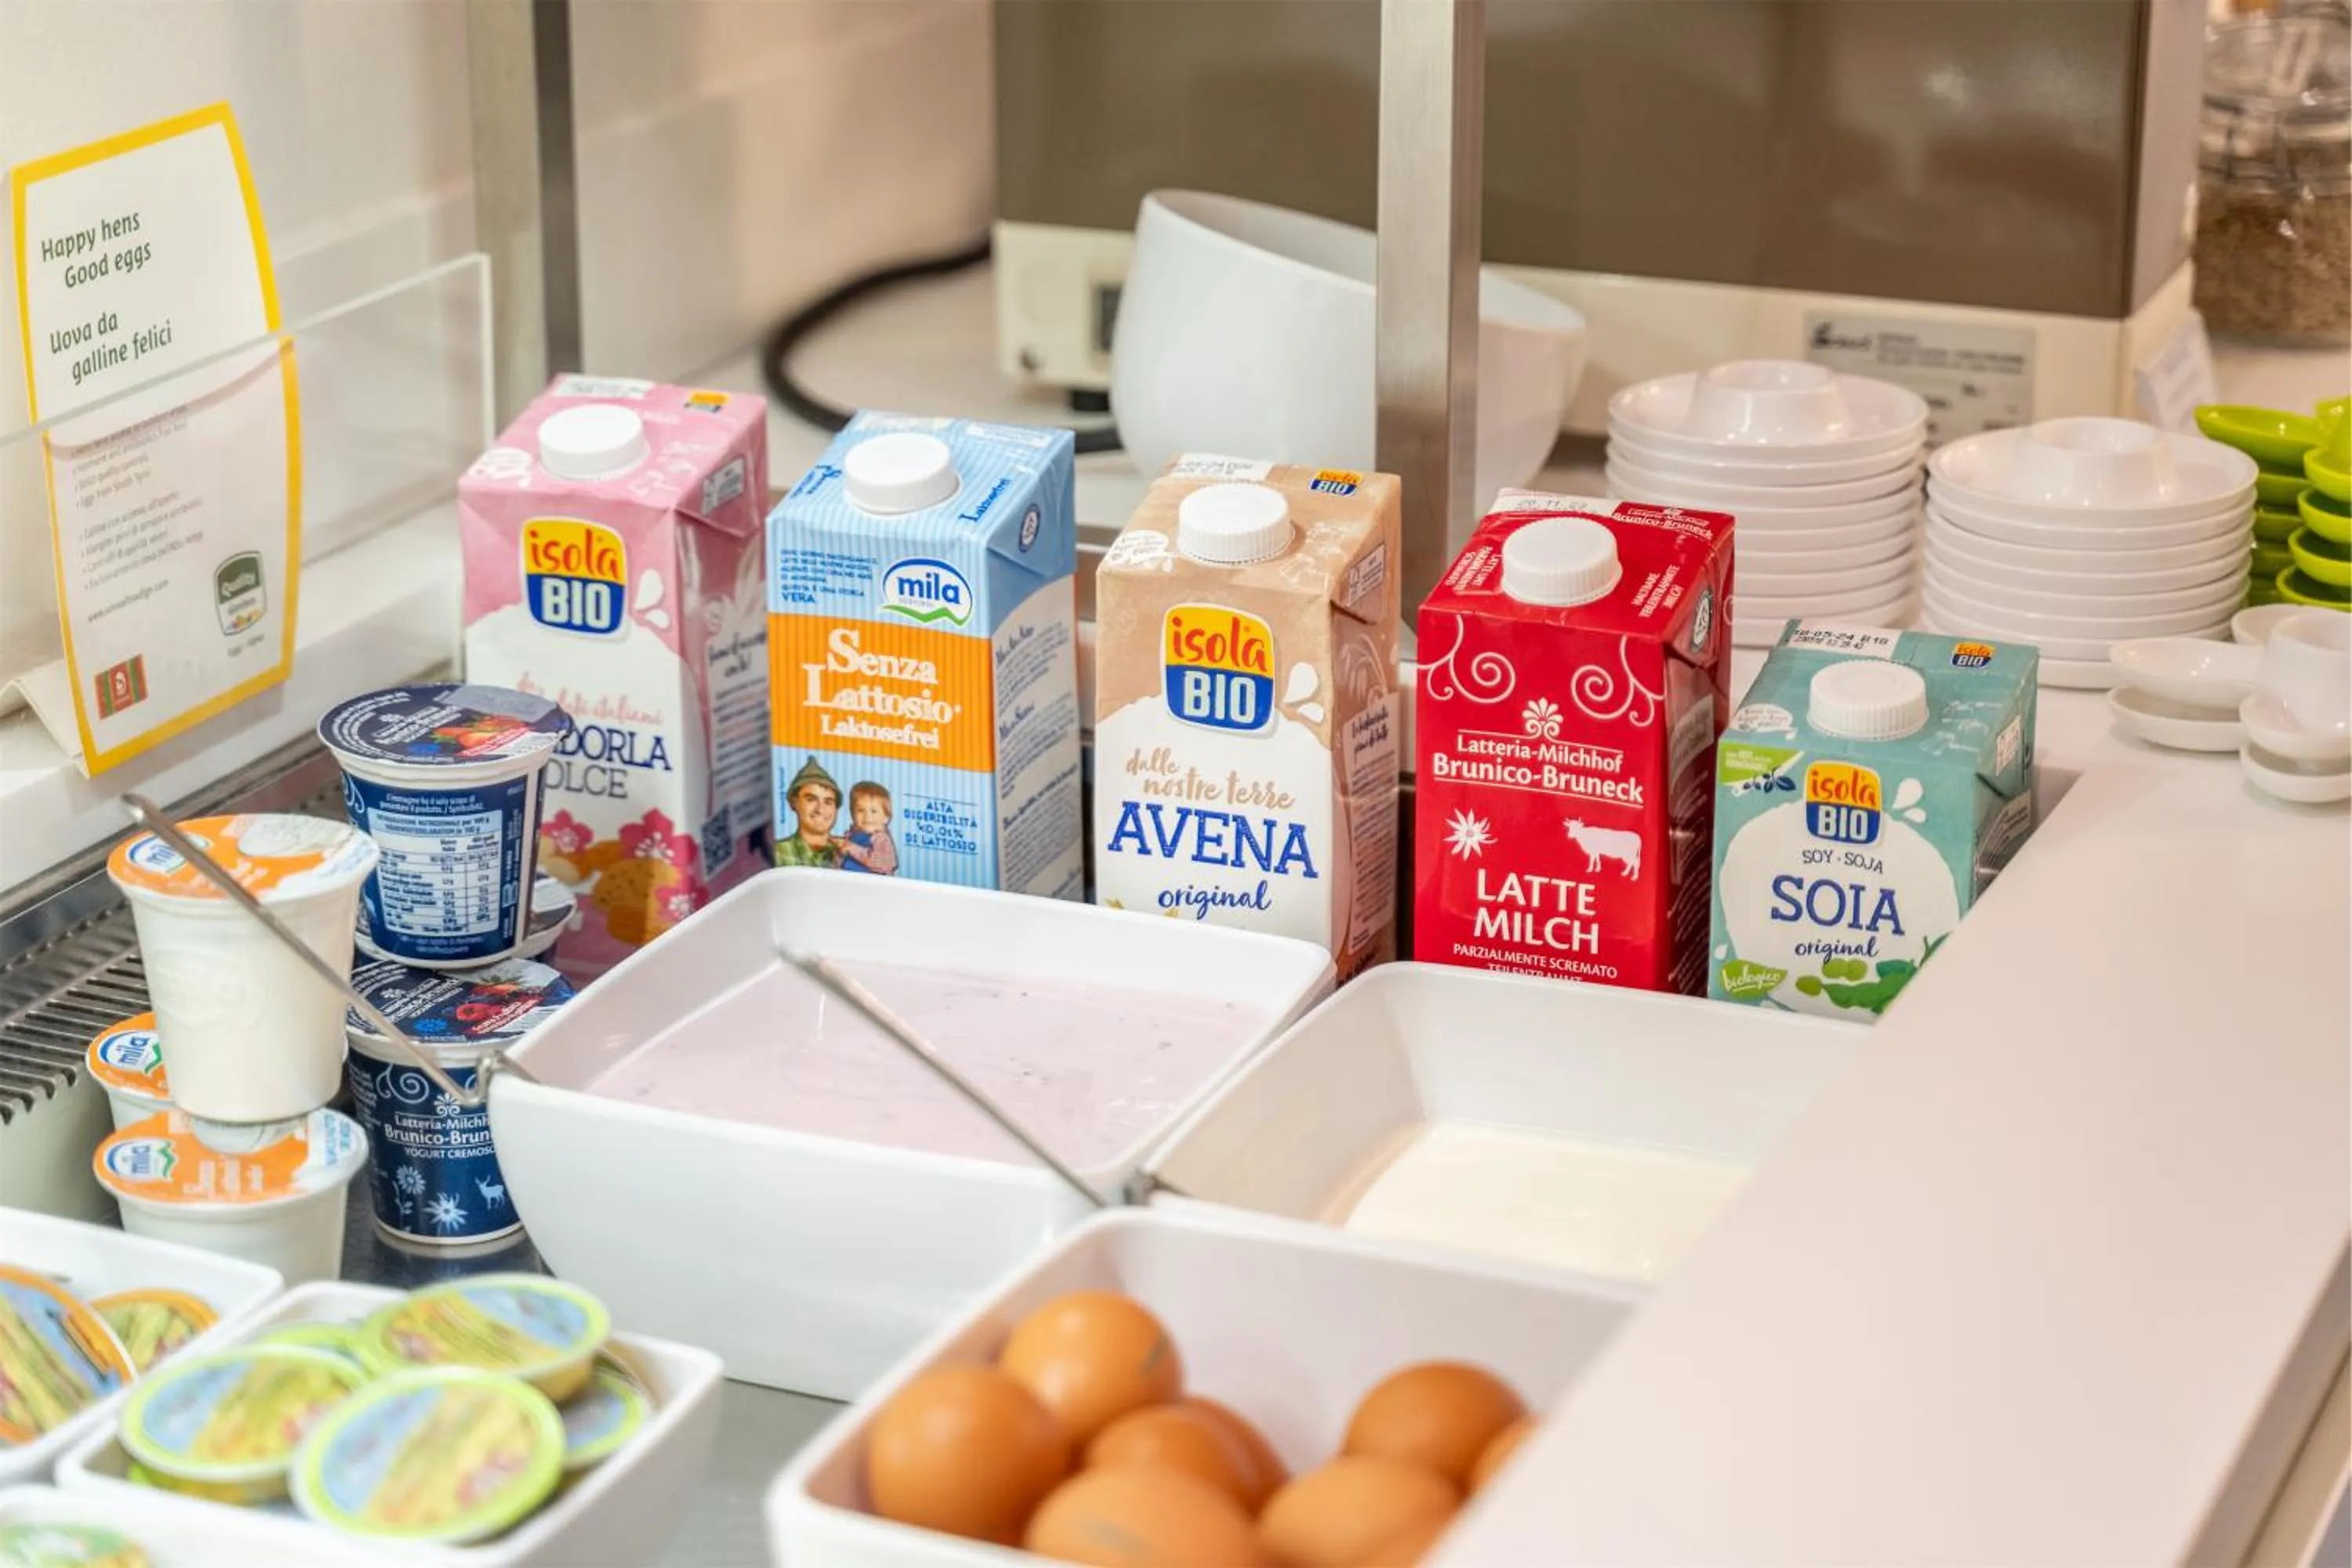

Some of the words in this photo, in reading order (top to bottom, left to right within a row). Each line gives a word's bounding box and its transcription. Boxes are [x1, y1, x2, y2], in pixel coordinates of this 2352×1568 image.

[41, 227, 96, 262] Happy
[101, 212, 140, 241] hens
[64, 253, 109, 289] Good
[114, 242, 152, 273] eggs
[49, 322, 93, 354] Uova
[97, 311, 118, 335] da
[71, 340, 128, 386] galline
[132, 320, 172, 361] felici
[528, 528, 621, 581] isola
[541, 577, 612, 630] BIO
[897, 572, 960, 604] mila
[827, 628, 938, 684] Senza
[1172, 616, 1267, 673] isola
[1957, 655, 1984, 666] BIO
[1184, 670, 1255, 724] BIO
[553, 724, 672, 771] DORLA
[821, 715, 939, 750] Laktosefrei
[1126, 748, 1179, 776] dalle
[1457, 735, 1624, 773] Latteria-Milchhof
[544, 758, 628, 799] OLCE
[1143, 767, 1225, 800] nostre
[1227, 771, 1295, 810] terre
[1433, 753, 1643, 804] Brunico-Bruneck
[1810, 771, 1877, 807] isola
[927, 801, 953, 813] ALTA
[1817, 804, 1868, 841] BIO
[922, 835, 977, 851] LATTOSIO
[1108, 801, 1319, 879] AVENA
[1802, 849, 1833, 864] SOY
[1844, 853, 1883, 873] SOJA
[1158, 880, 1272, 920] original
[1478, 868, 1595, 916] LATTE
[1771, 874, 1905, 935] SOIA
[1474, 907, 1599, 954] MILCH
[1454, 943, 1547, 967] PARZIALMENTE
[1549, 957, 1618, 978] SCREMATO
[1795, 937, 1878, 965] original
[1722, 965, 1781, 992] biologico
[117, 1036, 151, 1065] mila
[384, 1123, 491, 1145] Brunico-Brun
[394, 1114, 489, 1131] Latteria-Milchh
[130, 1145, 150, 1174] mila
[405, 1147, 445, 1159] YOGURT
